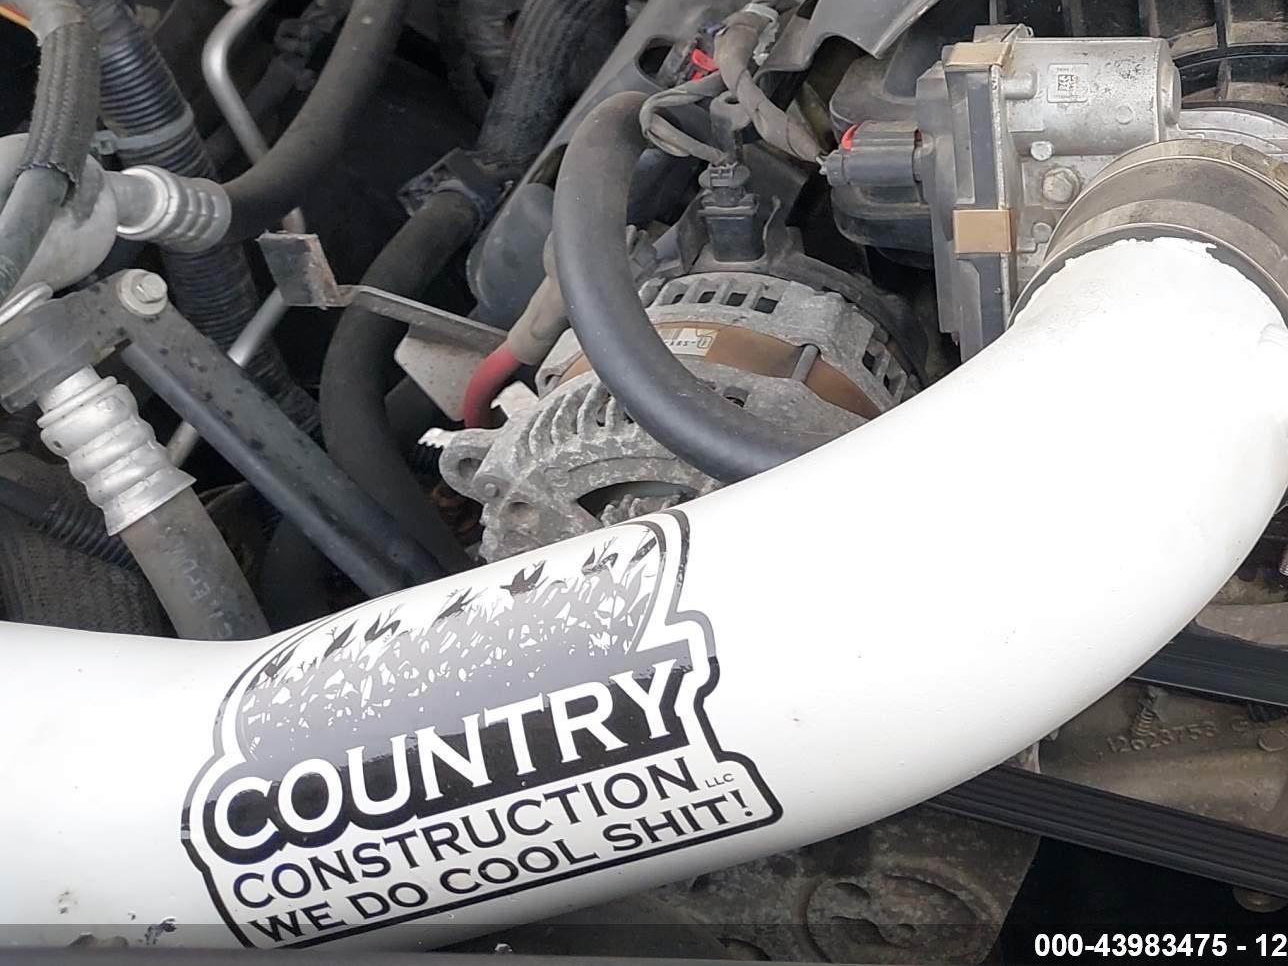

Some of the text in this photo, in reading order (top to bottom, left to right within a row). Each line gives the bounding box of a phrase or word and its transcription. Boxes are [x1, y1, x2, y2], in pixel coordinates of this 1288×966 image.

[214, 658, 678, 850] COUNTRY
[233, 756, 736, 908] CONSTRUCTION LLC
[247, 789, 754, 943] WE DO COOL SHIT!
